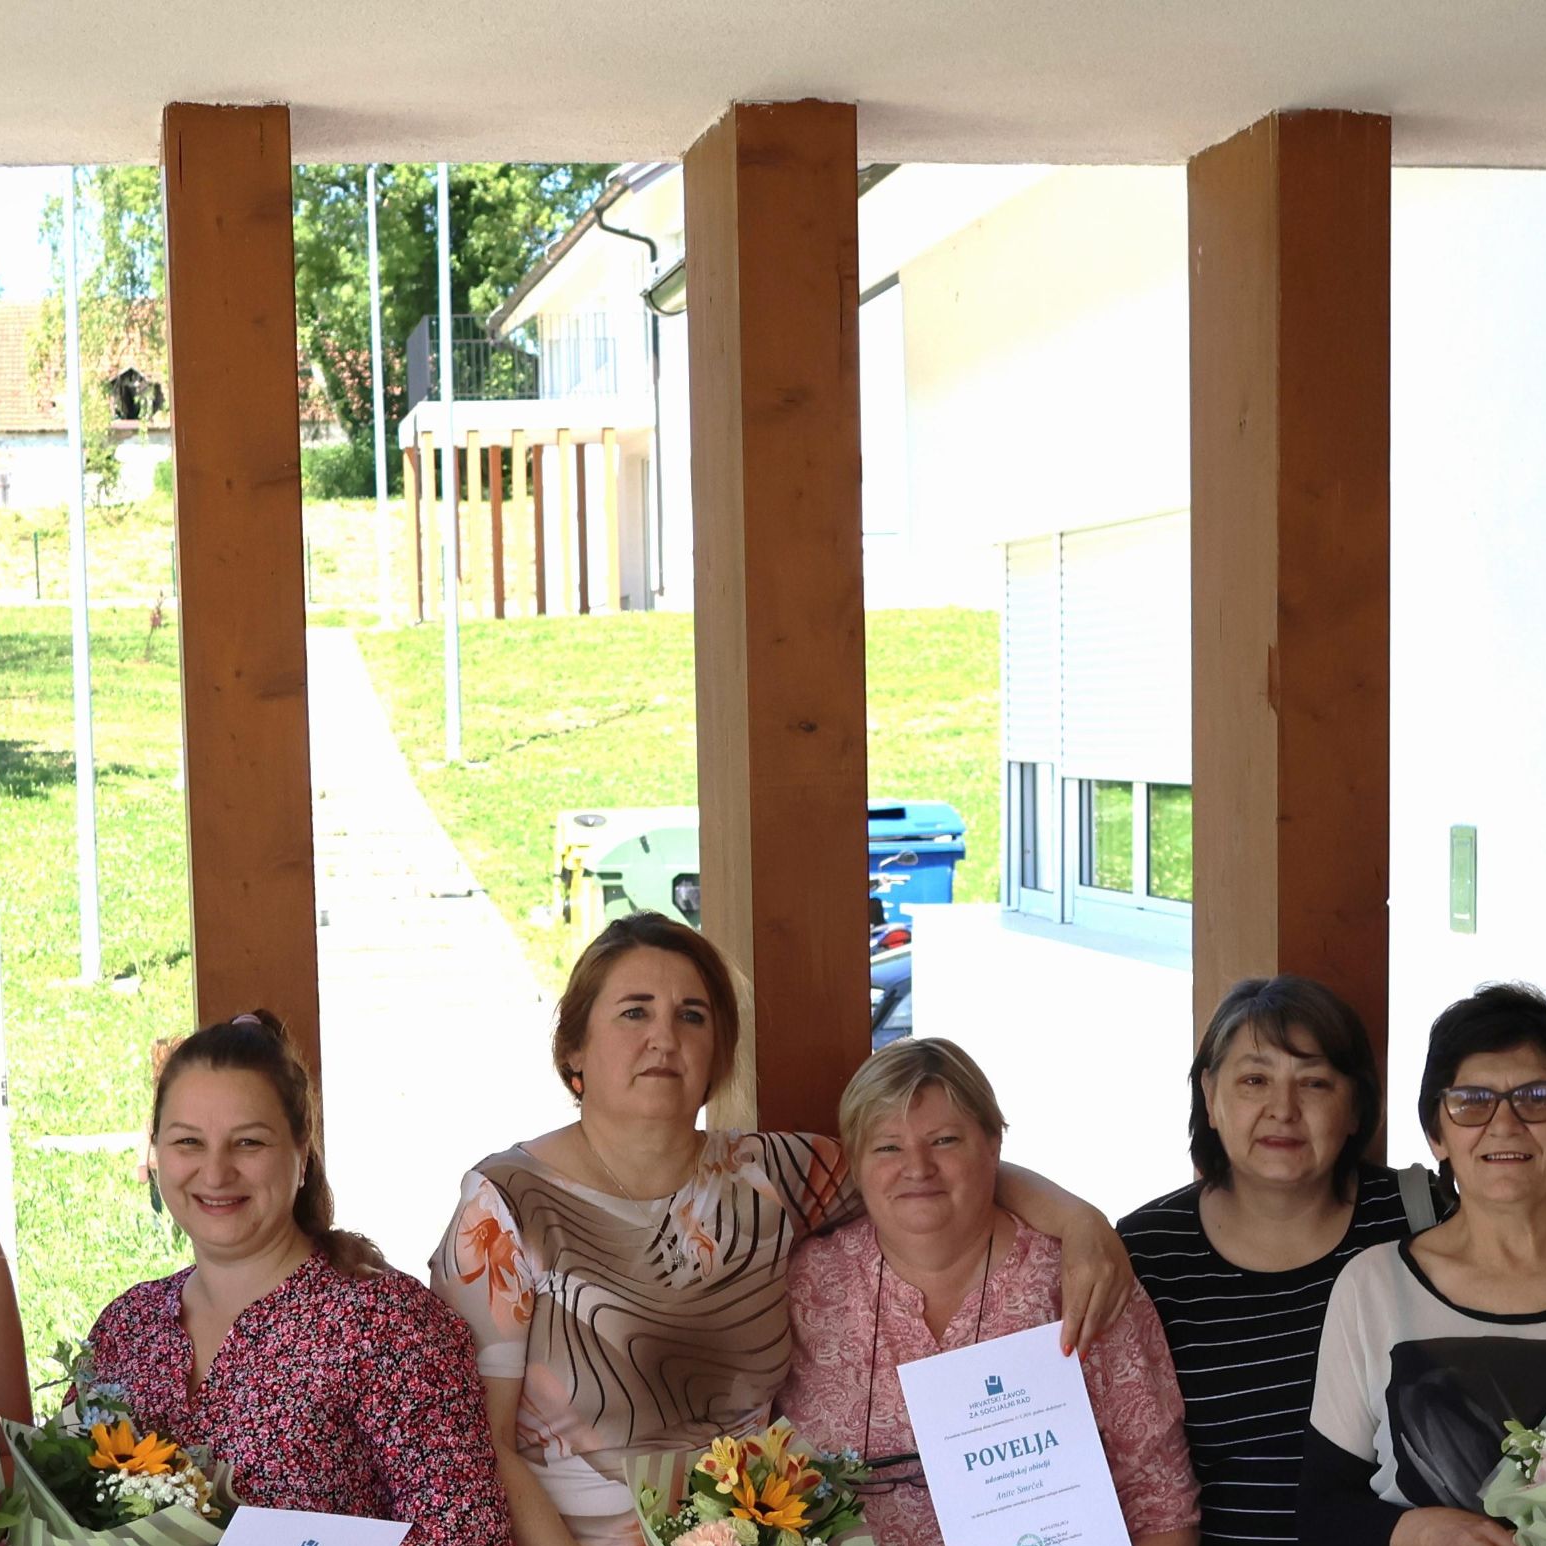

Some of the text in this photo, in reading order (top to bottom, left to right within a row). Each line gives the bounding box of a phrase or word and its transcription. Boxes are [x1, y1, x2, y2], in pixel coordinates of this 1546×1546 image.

[968, 1388, 1026, 1410] HRVATSKI ZAVOD
[969, 1410, 979, 1419] ZA
[1016, 1396, 1031, 1405] RAD
[963, 1429, 1060, 1472] POVELJA
